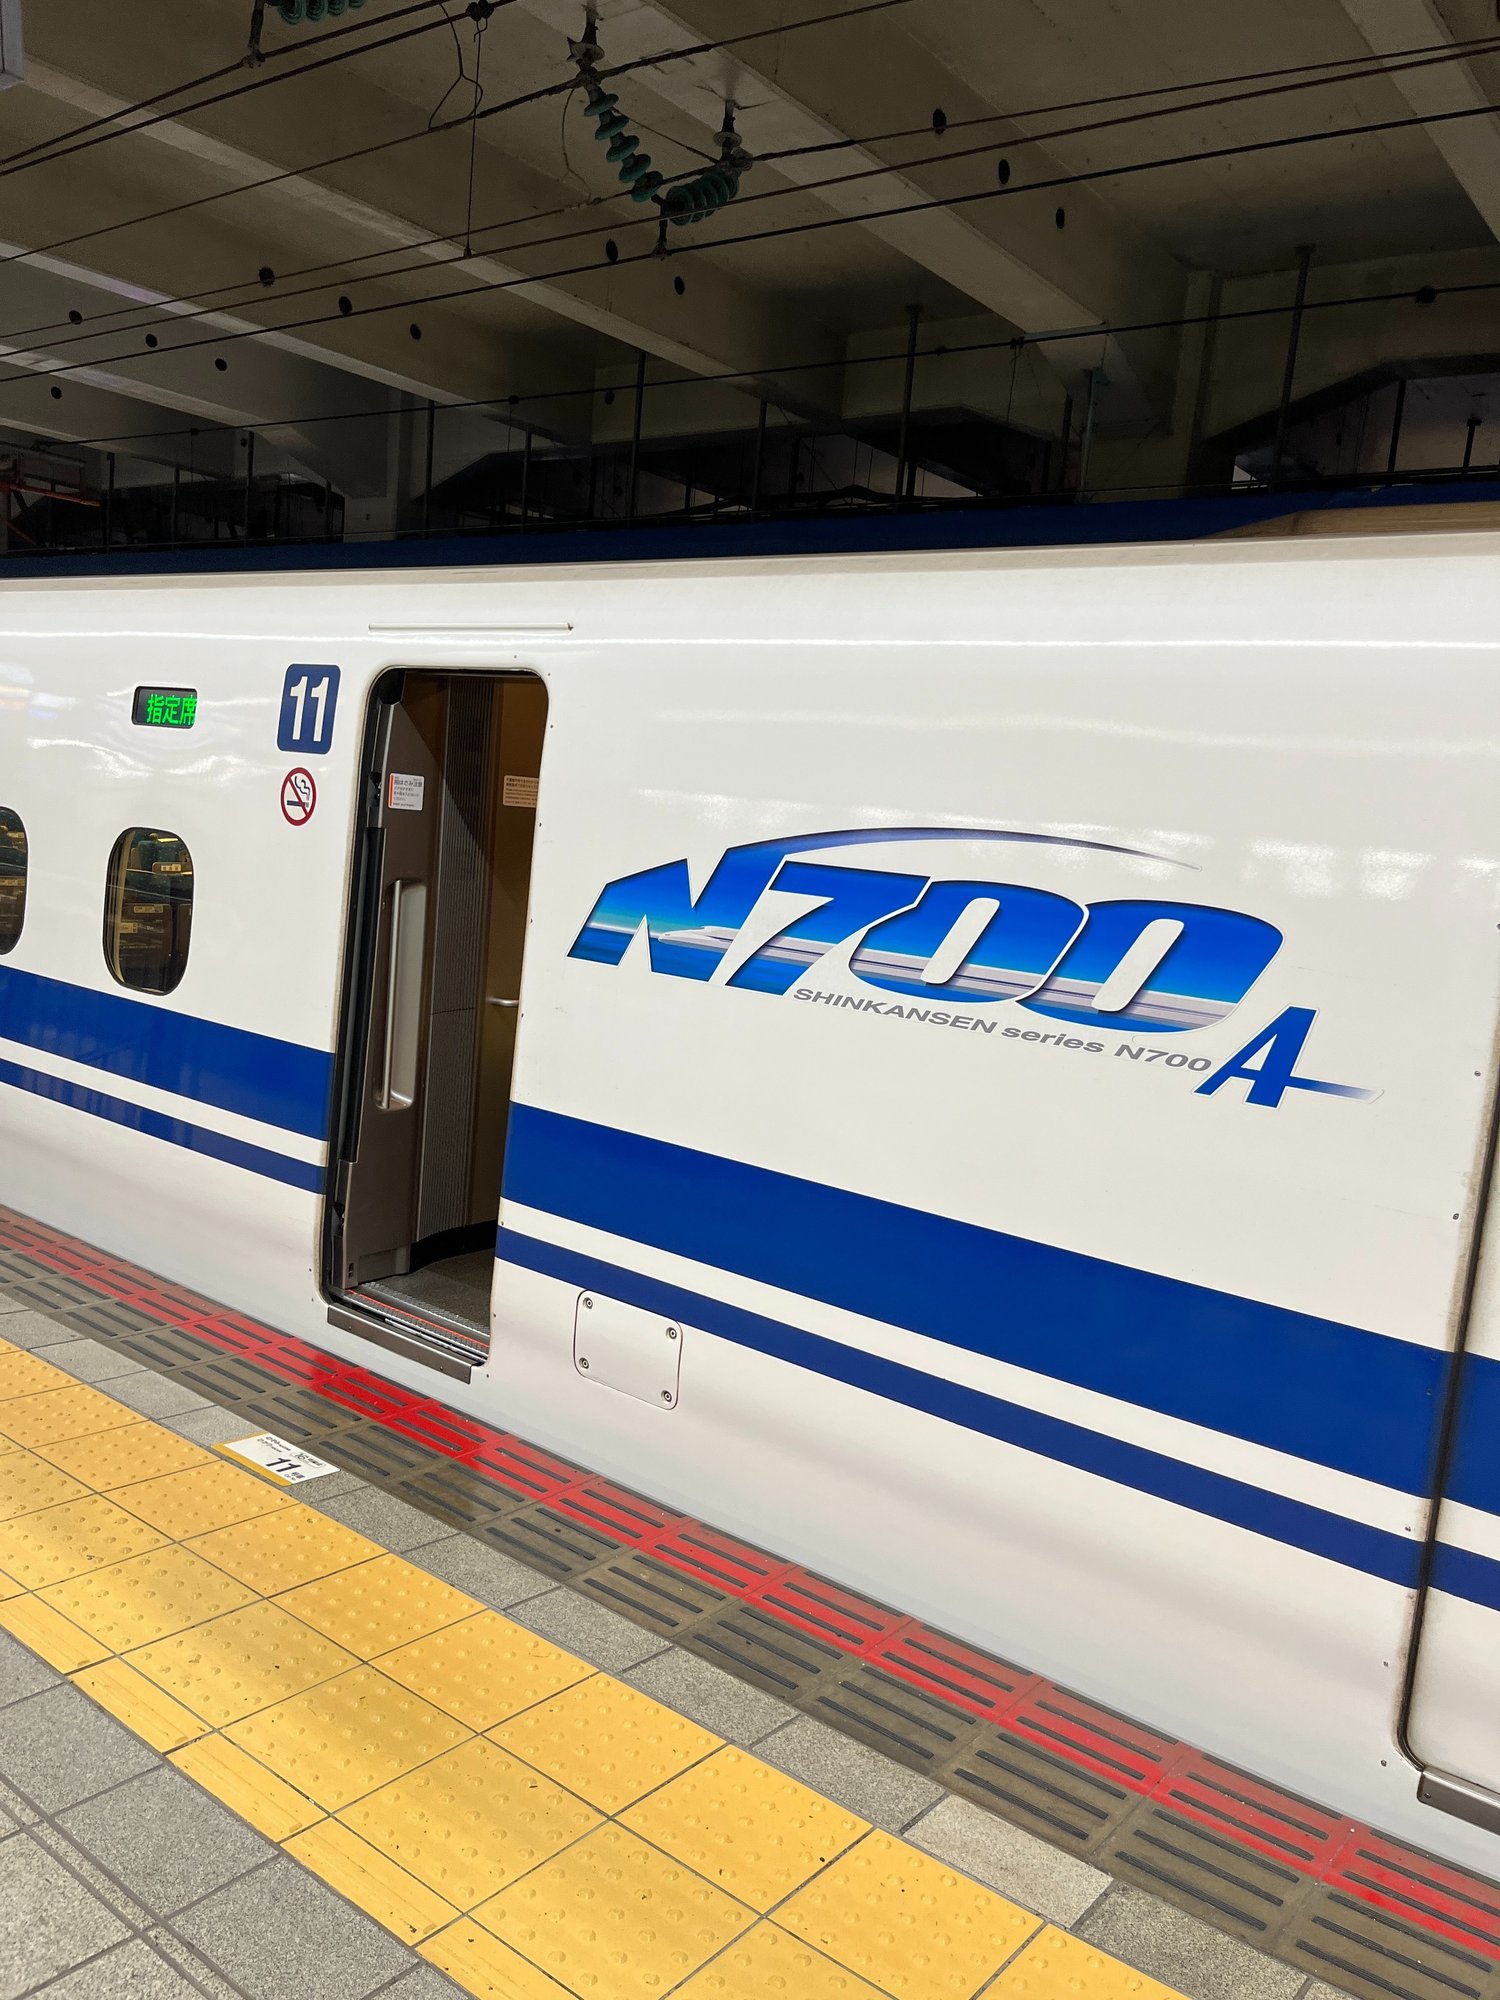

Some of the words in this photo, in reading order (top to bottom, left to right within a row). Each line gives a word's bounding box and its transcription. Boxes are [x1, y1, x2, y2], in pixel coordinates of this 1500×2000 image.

[147, 694, 197, 726] 指定席
[290, 676, 330, 743] 11
[566, 826, 1285, 1034] N700
[1194, 1006, 1340, 1108] A
[793, 988, 999, 1034] SHINKANSEN
[1001, 1026, 1104, 1053] series
[1114, 1044, 1212, 1072] N700
